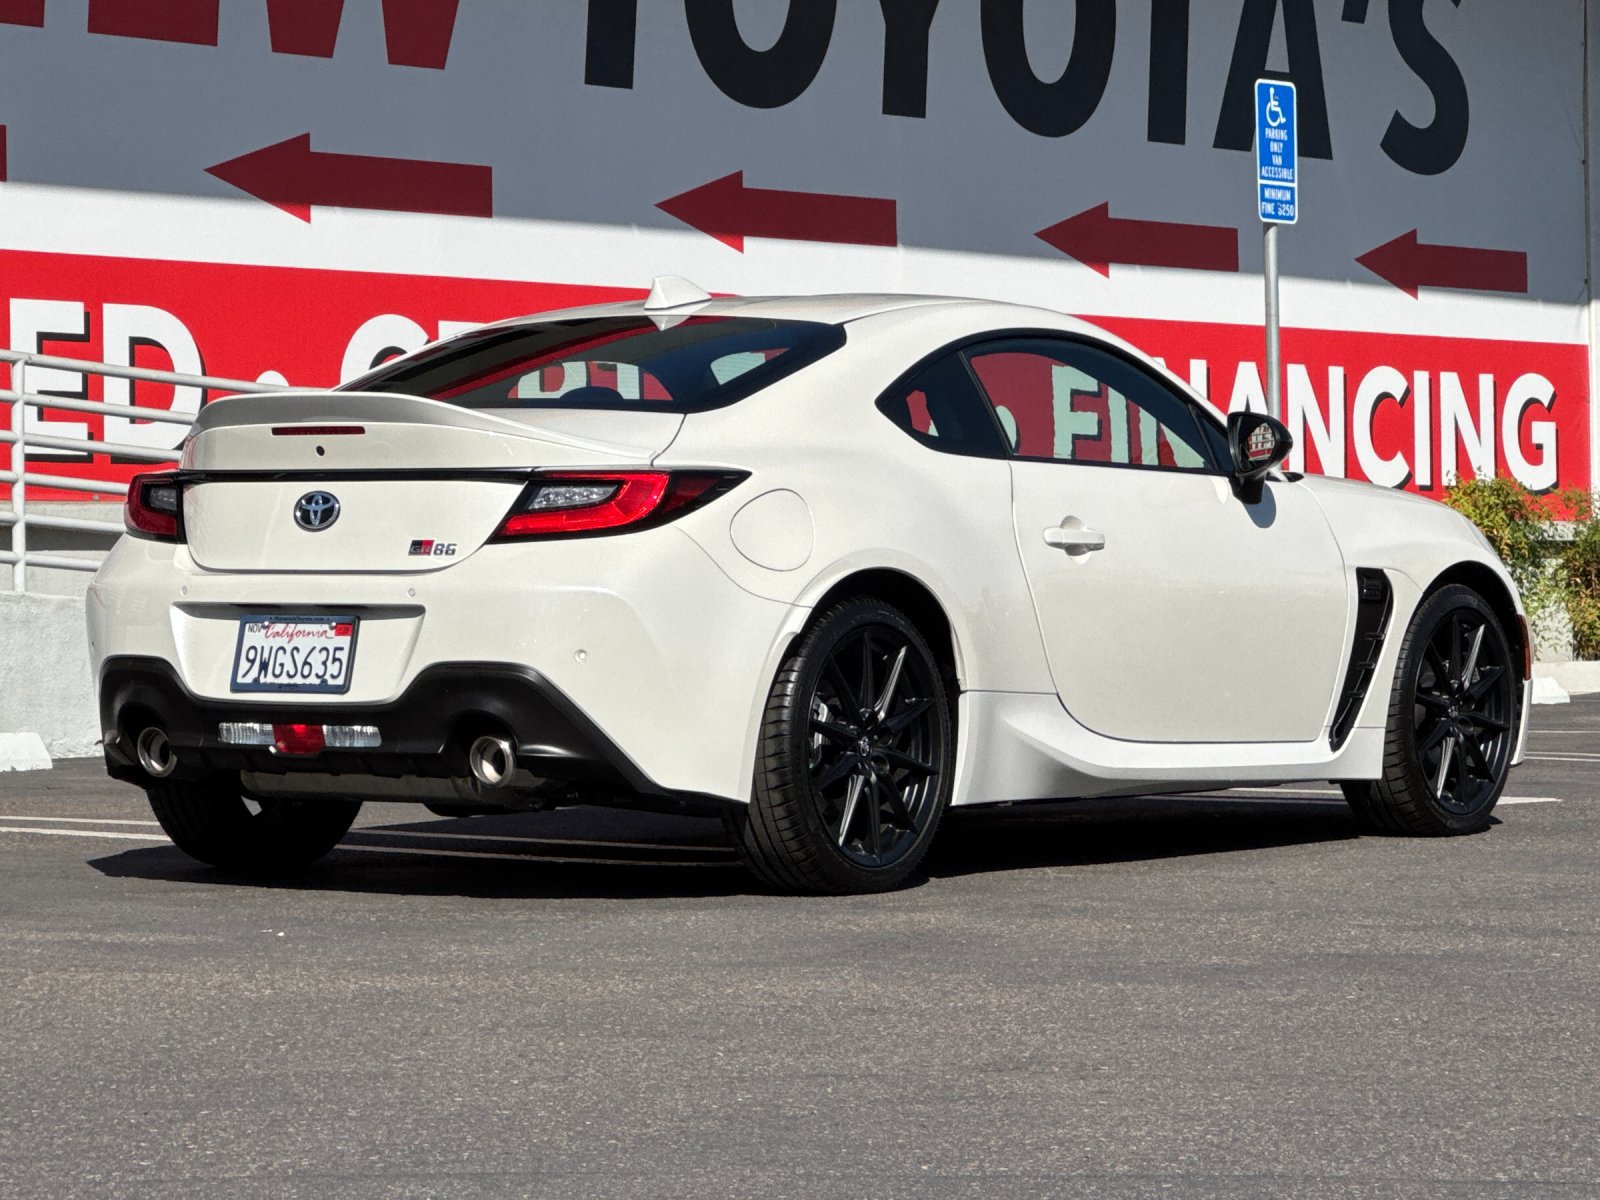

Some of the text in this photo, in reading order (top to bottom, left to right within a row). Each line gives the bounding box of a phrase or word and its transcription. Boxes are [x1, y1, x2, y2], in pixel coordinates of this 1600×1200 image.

[1265, 127, 1287, 140] PARKING
[1270, 141, 1283, 153] ONLY
[1272, 154, 1282, 166] VAN
[1261, 166, 1293, 180] ACCESSIBLE
[1264, 188, 1291, 201] MINIMUM
[1261, 202, 1294, 217] FINE $250
[264, 622, 334, 644] California
[241, 645, 344, 679] 9WGS635
